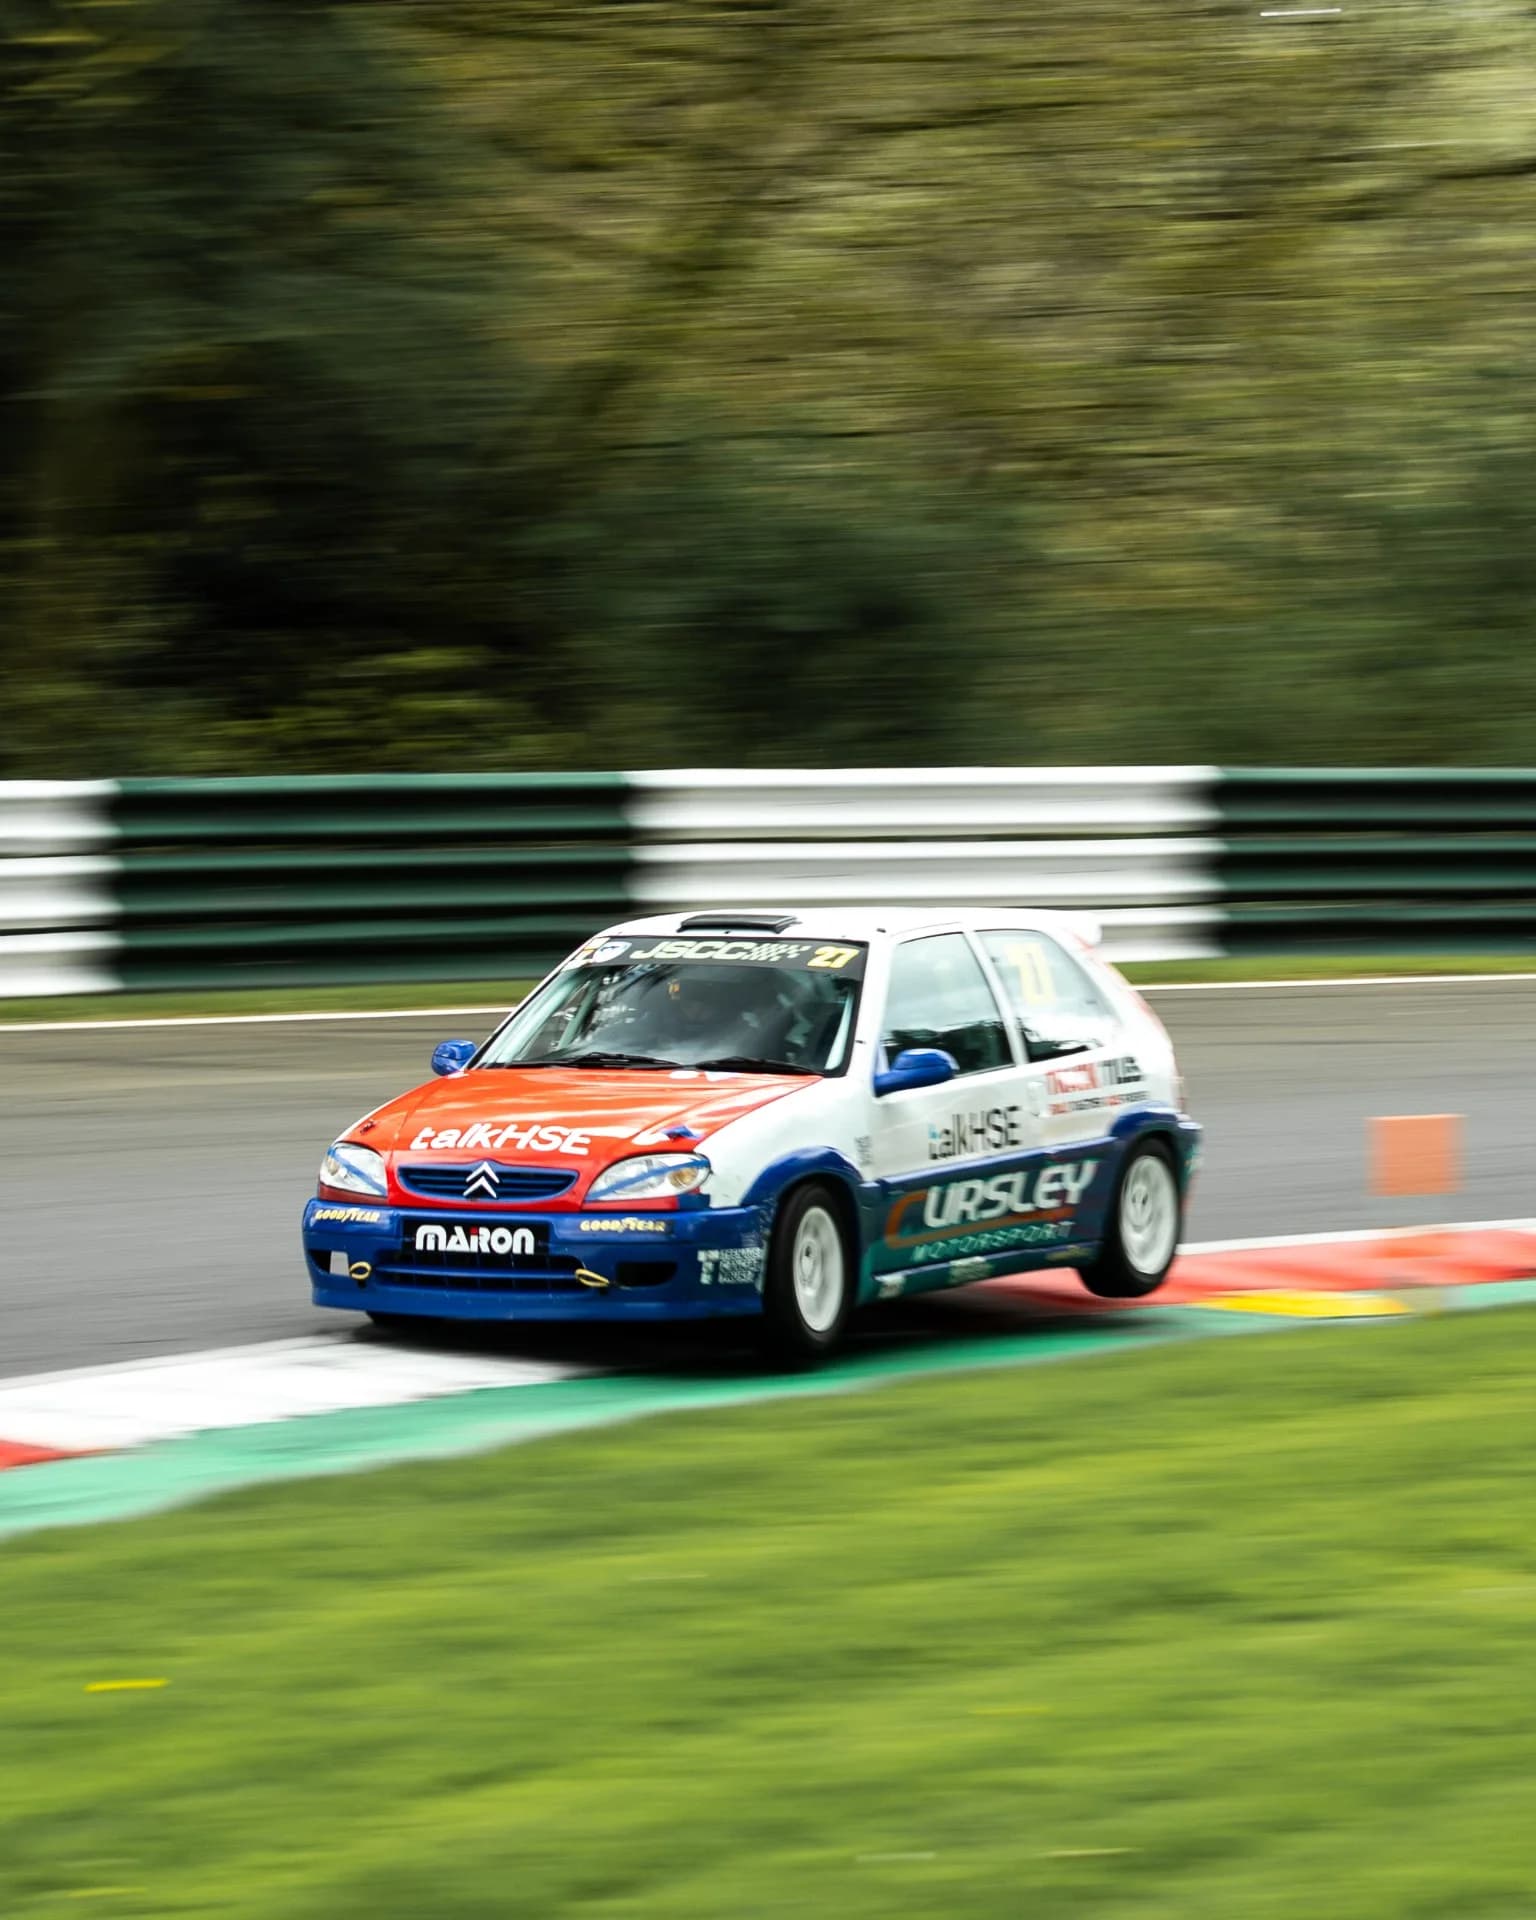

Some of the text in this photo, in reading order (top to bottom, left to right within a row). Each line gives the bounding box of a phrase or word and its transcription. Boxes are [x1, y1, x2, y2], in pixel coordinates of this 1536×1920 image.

[629, 941, 757, 960] JSCC
[807, 946, 859, 968] 27
[410, 1123, 592, 1155] talkHSE
[314, 1207, 380, 1223] GOODYEAR
[579, 1217, 666, 1233] GOODYEAR
[913, 1221, 1076, 1262] MOTORSPORT
